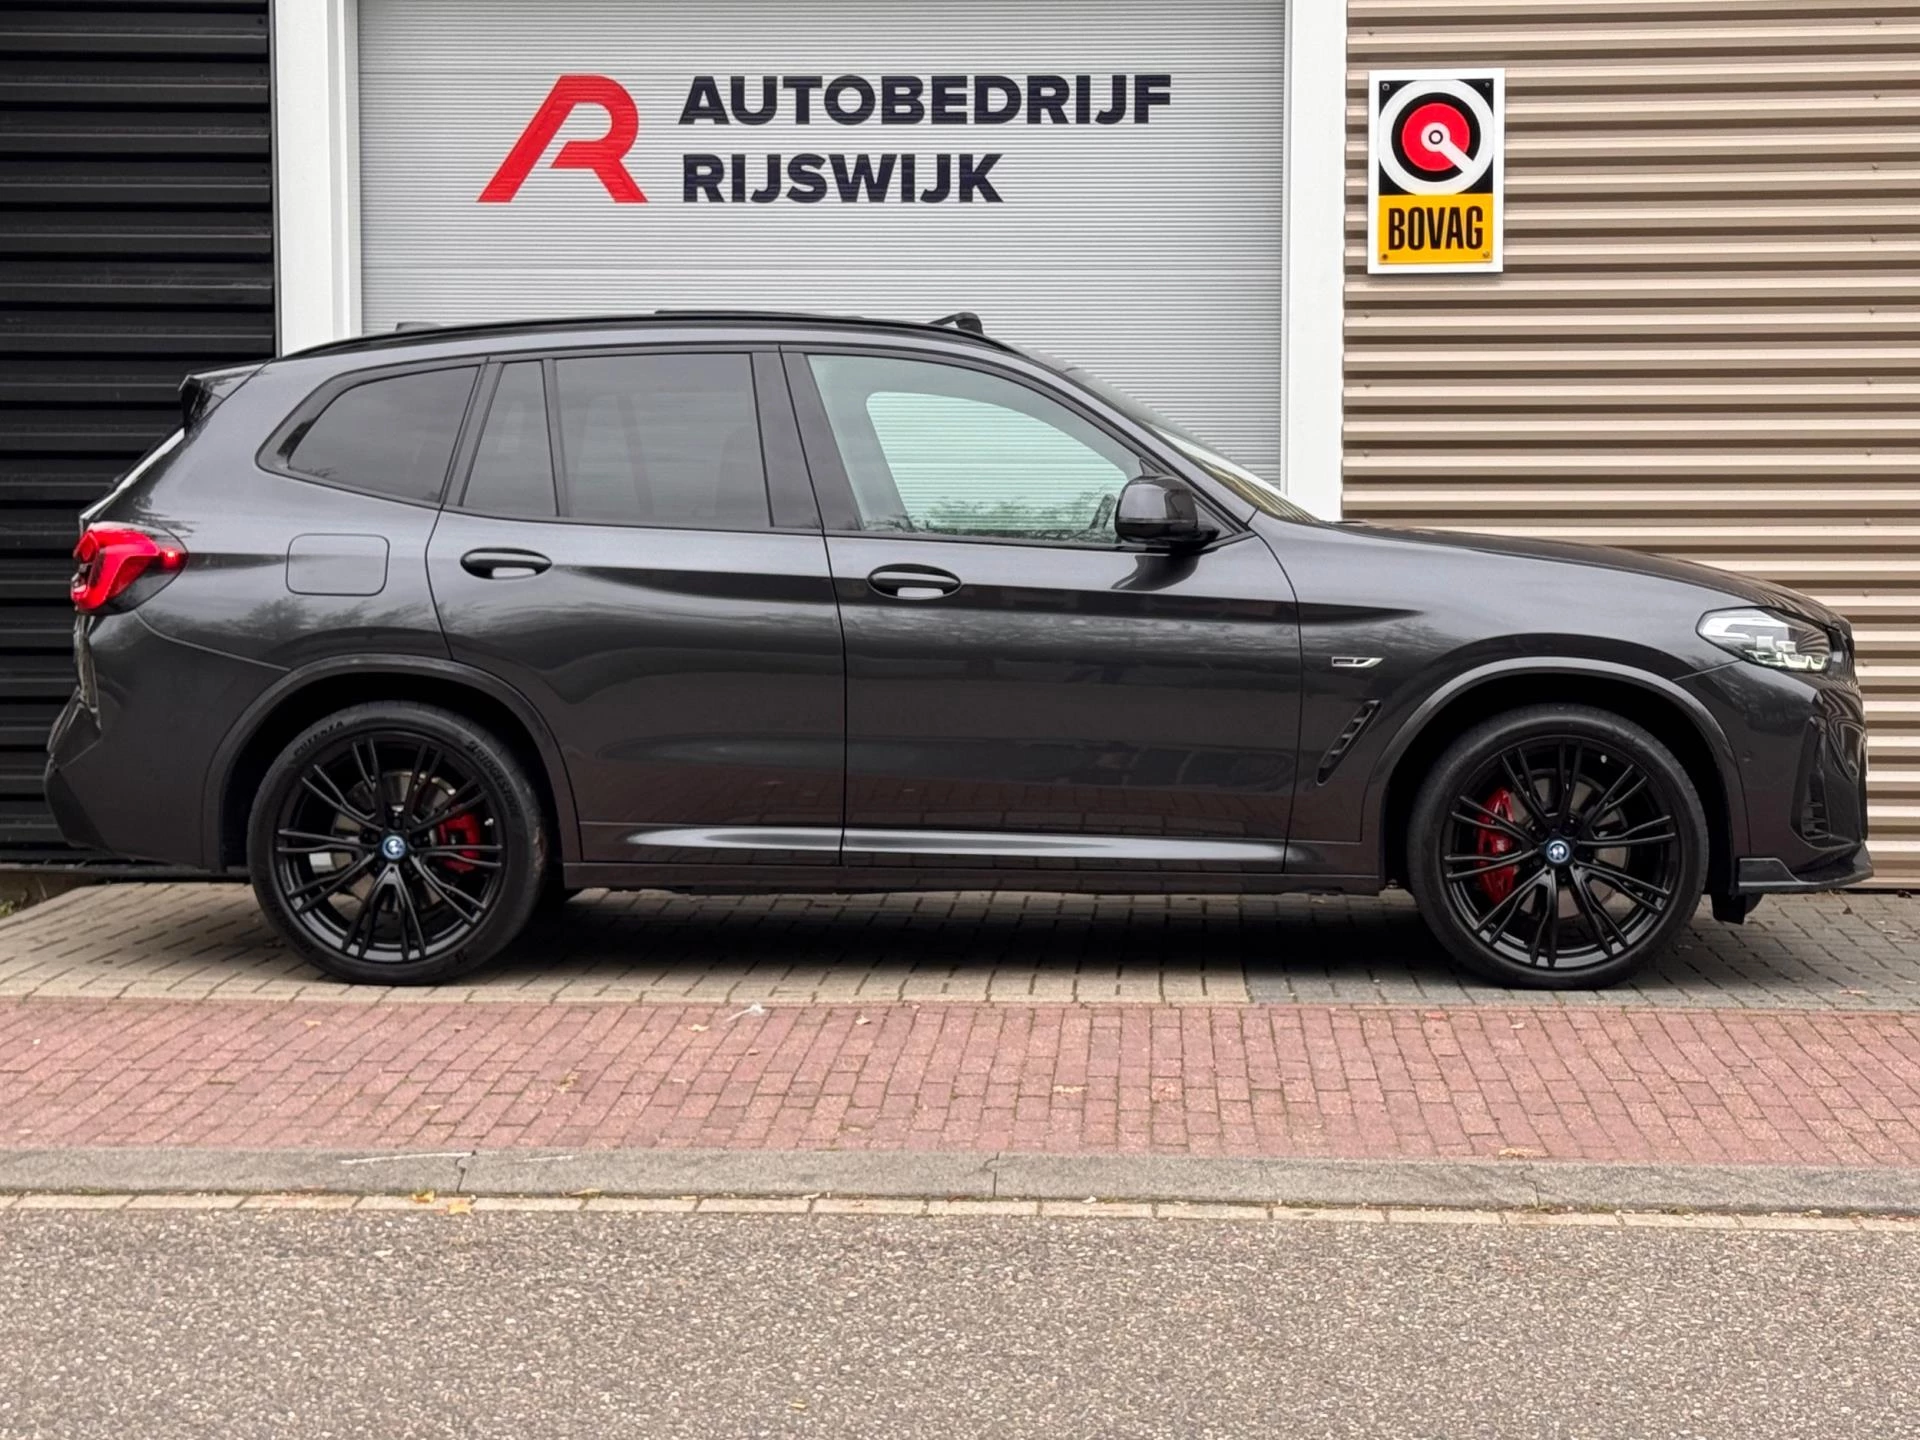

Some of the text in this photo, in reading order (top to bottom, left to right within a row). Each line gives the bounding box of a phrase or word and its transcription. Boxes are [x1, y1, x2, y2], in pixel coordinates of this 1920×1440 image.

[679, 74, 1172, 125] AUTOBEDRIJF
[683, 153, 1003, 203] RIJSWIJK
[1388, 205, 1484, 250] BOVAG
